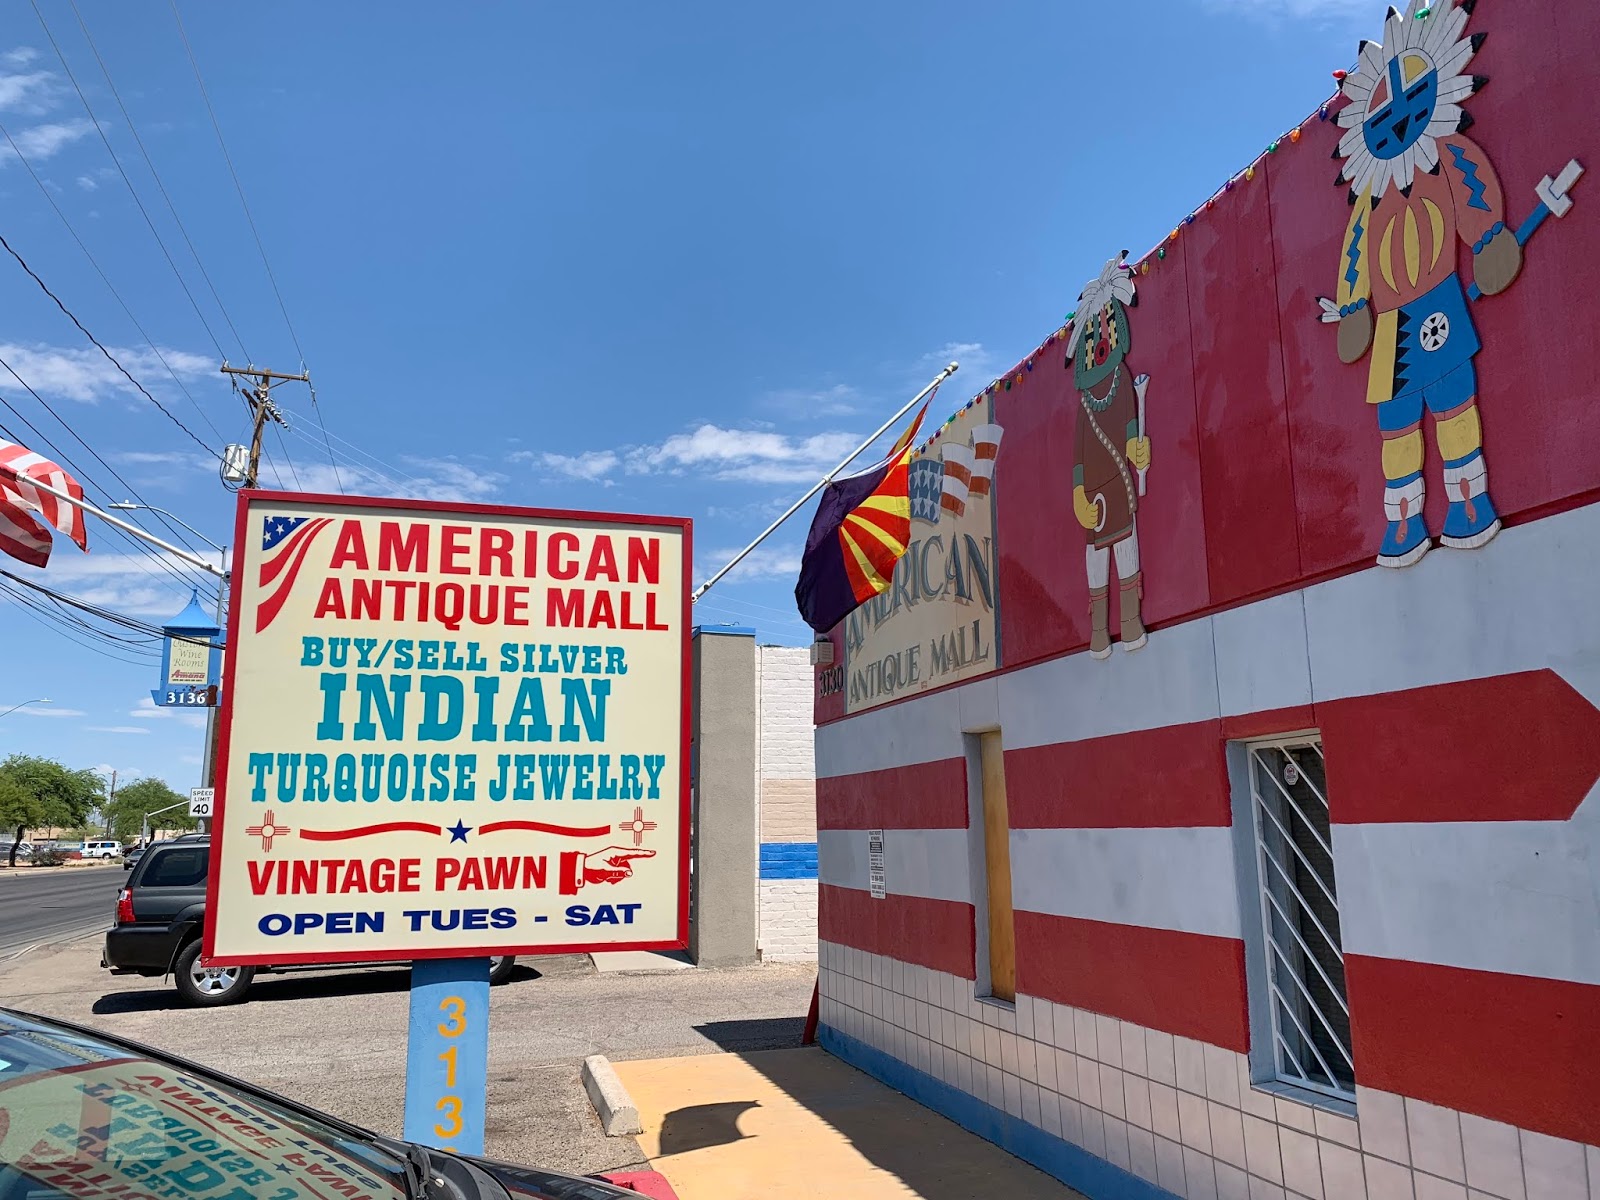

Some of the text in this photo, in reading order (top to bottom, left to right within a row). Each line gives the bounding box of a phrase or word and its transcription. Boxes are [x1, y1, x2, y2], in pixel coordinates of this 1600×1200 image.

[329, 519, 660, 585] AMERICAN
[313, 577, 669, 631] ANTIQUE MALL
[173, 659, 205, 667] Rooms
[178, 649, 203, 659] Wine
[301, 636, 628, 675] BUY/SELL SILVER
[849, 619, 990, 705] ANTIQUE MALL
[167, 692, 206, 704] 3136
[317, 673, 611, 742] INDIAN
[248, 753, 666, 802] TURQUOISE JEWELRY
[192, 804, 208, 814] 40
[247, 856, 547, 896] VINTAGE PAWN
[257, 911, 385, 936] OPEN
[403, 907, 517, 932] TUES
[565, 903, 642, 926] SAT
